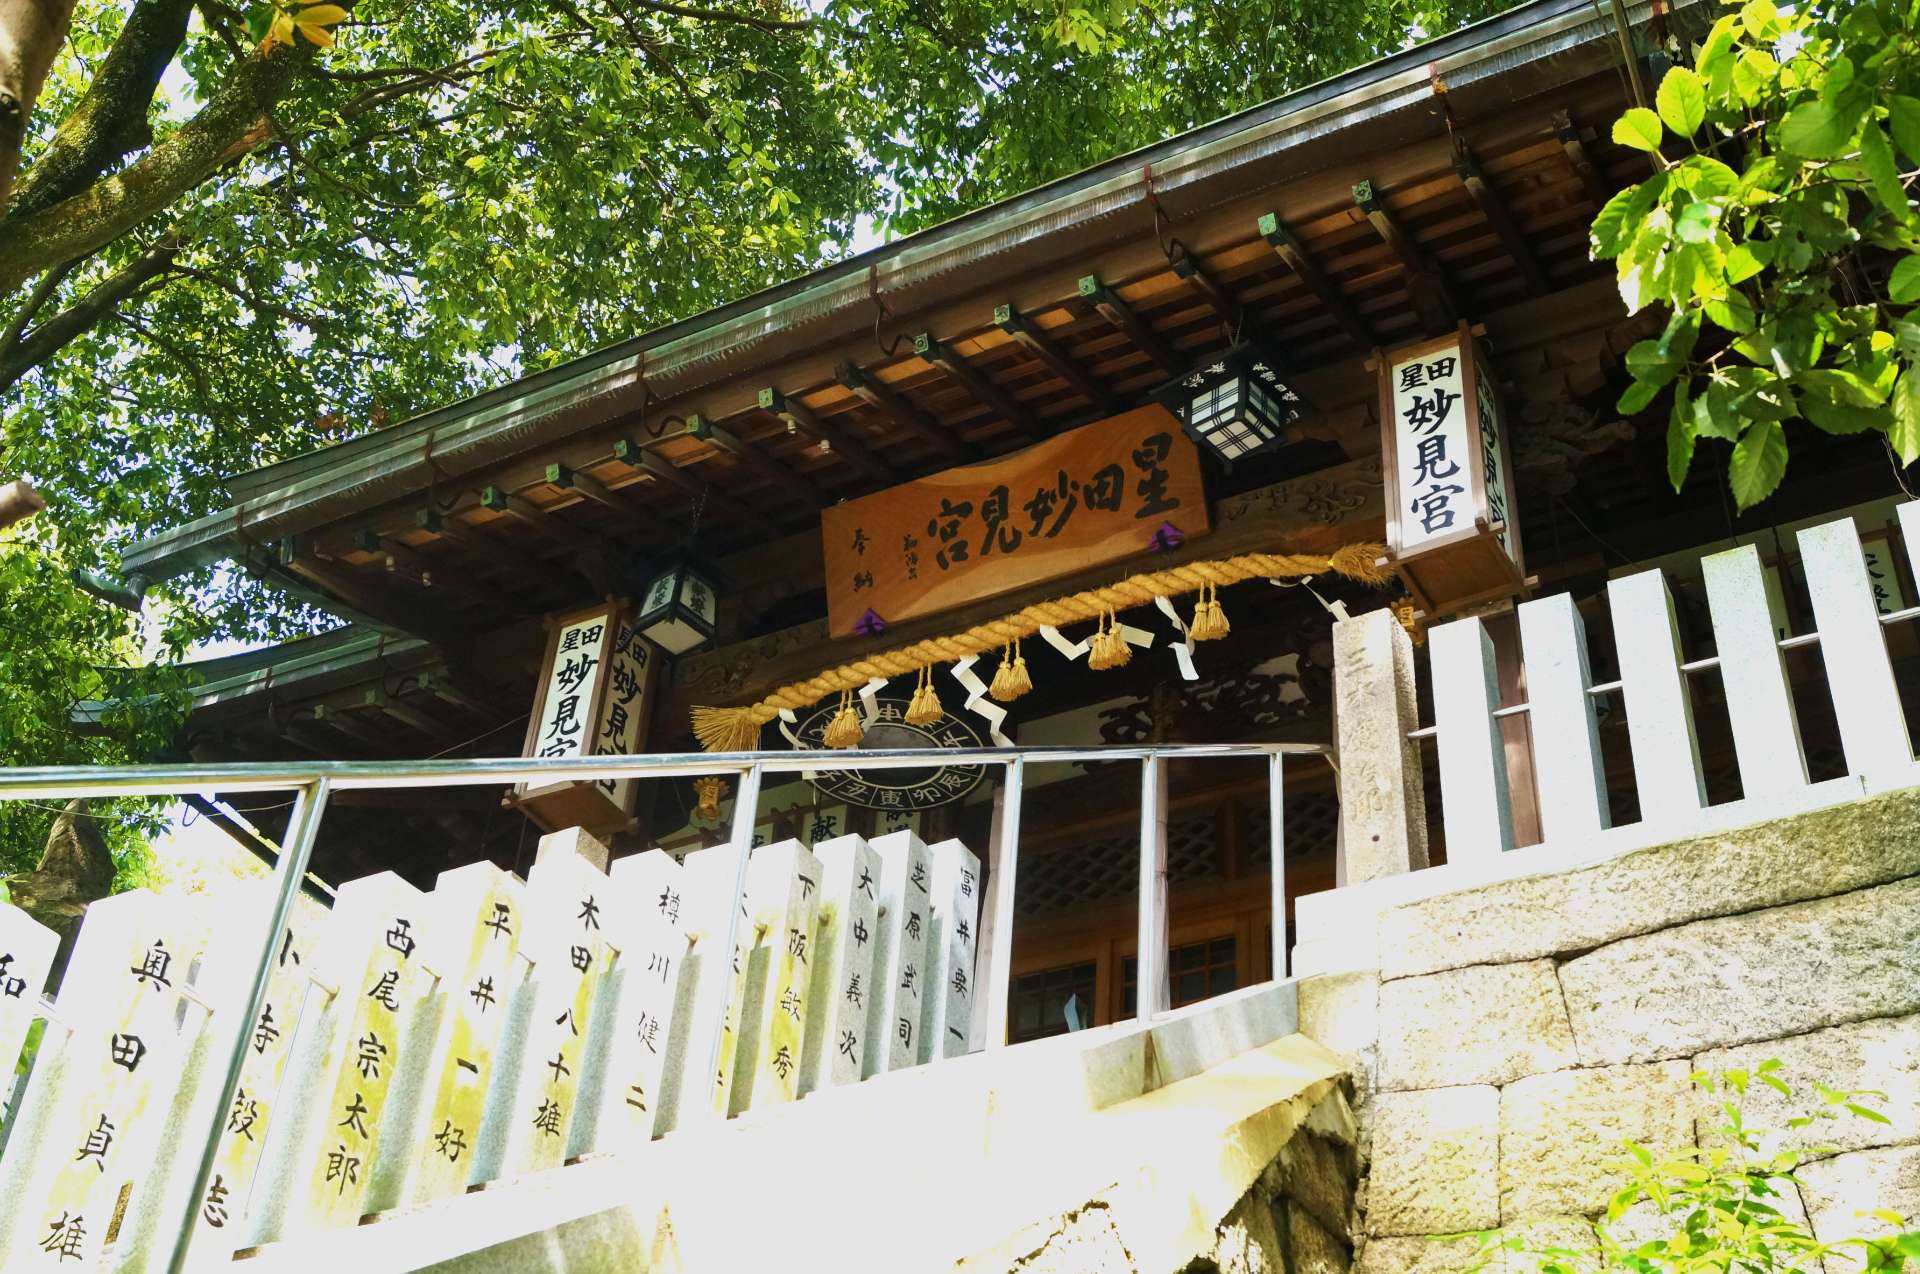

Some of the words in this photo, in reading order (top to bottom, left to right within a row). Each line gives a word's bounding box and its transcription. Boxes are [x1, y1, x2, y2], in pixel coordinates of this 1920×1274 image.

[927, 432, 1181, 571] 星田妙見宮
[39, 938, 173, 1264] 奥田貞雄
[326, 917, 417, 1196] 西尾宗太郎
[434, 902, 513, 1163] 平井一好
[532, 895, 601, 1138] 木田八十雄
[773, 873, 816, 1080] 下阪敏秀
